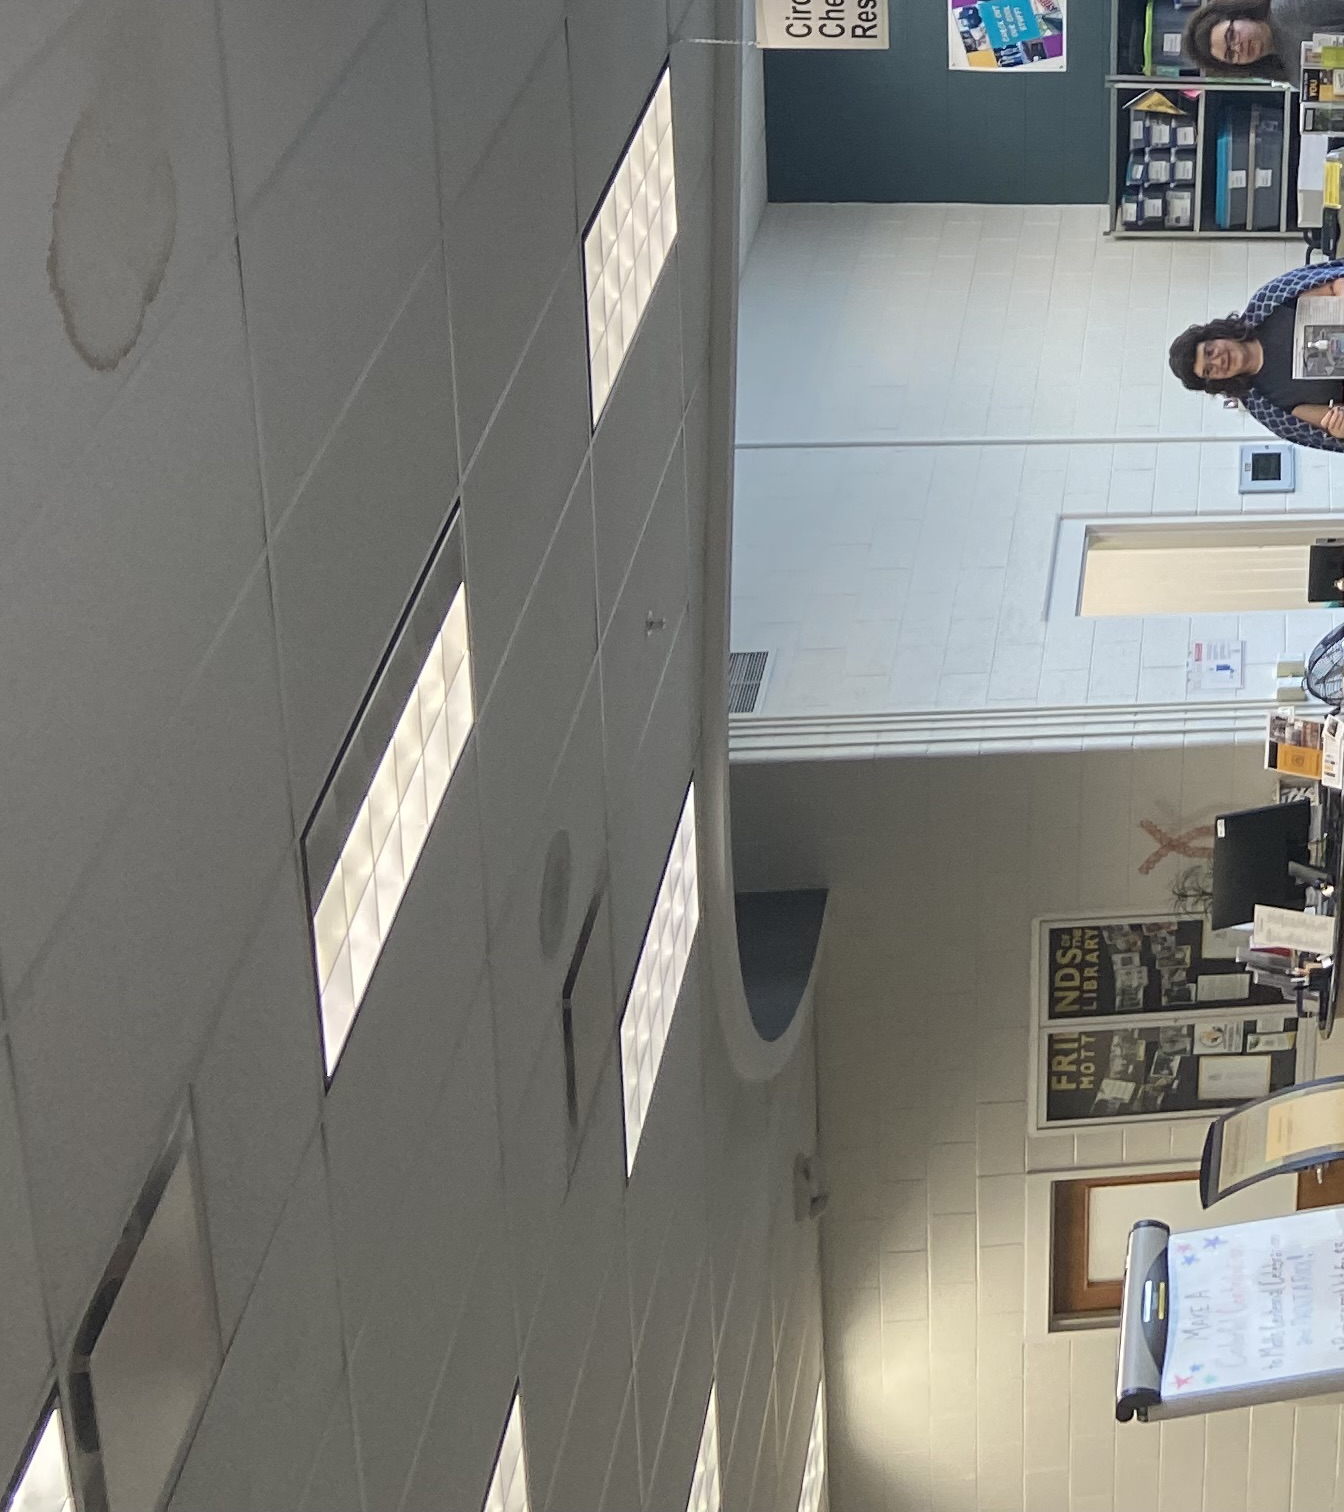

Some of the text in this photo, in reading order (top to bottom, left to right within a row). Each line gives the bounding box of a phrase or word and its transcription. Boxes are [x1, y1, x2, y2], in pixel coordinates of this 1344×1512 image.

[1051, 948, 1082, 1090] FRINDS
[1080, 927, 1100, 1088] MOTT LIBRARY
